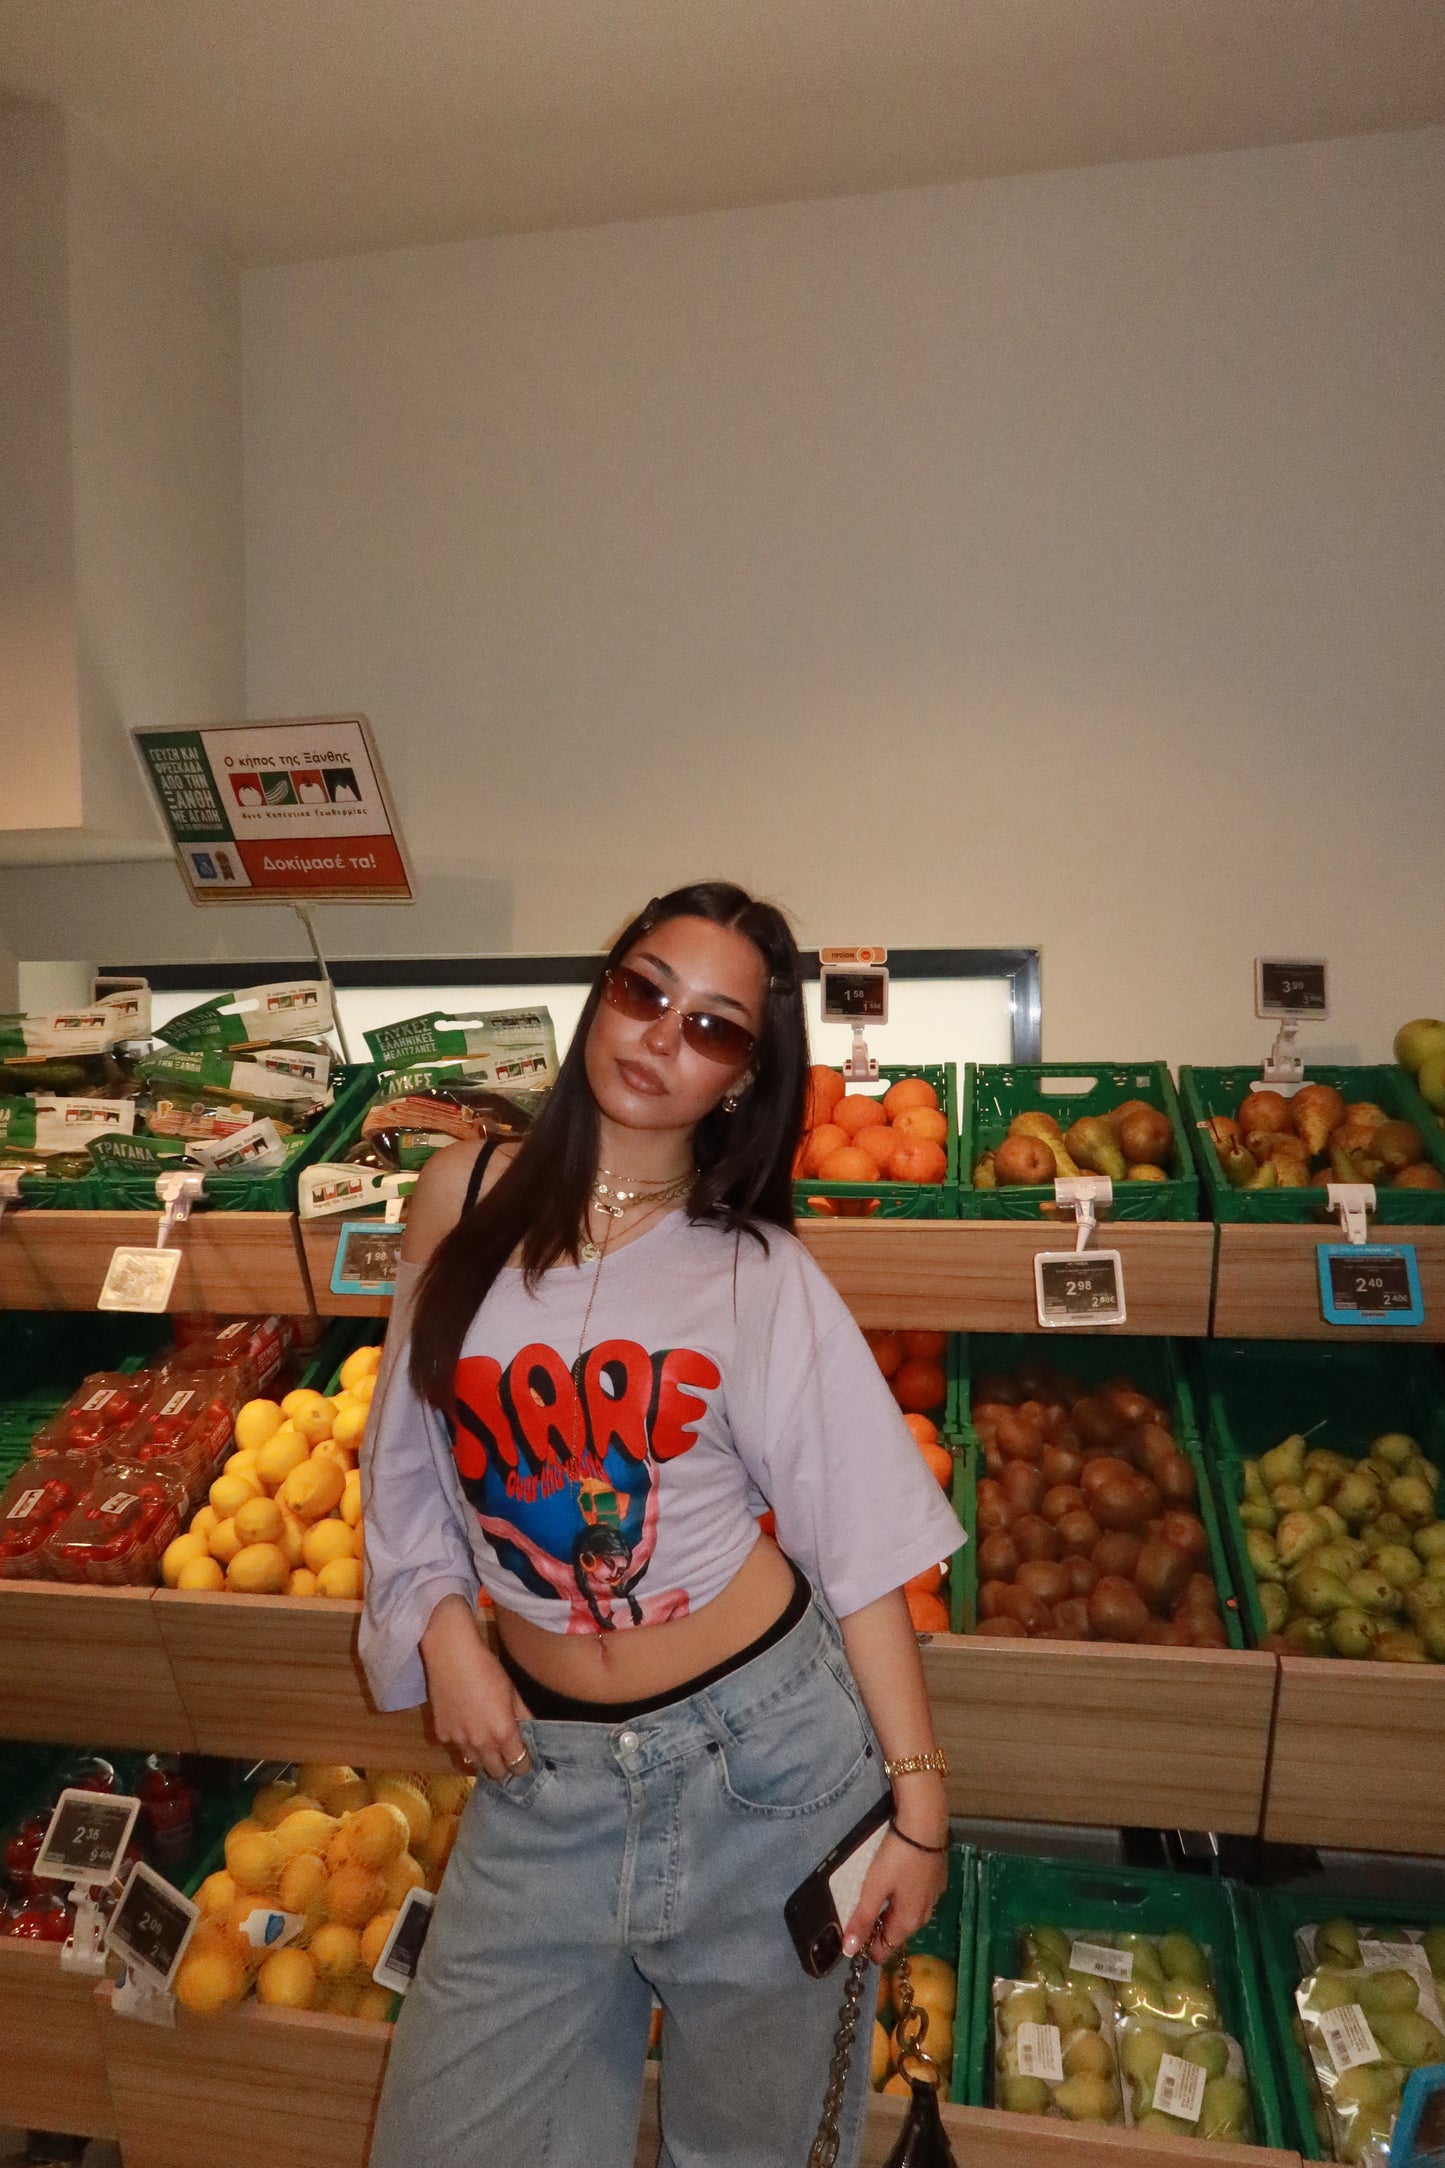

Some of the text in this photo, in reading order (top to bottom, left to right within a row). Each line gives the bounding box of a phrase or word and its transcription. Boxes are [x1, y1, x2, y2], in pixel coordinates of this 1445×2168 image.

[180, 746, 200, 760] ΚΑΙ
[238, 754, 276, 768] κήπος
[279, 755, 300, 767] της
[303, 750, 351, 764] Ξάνθης
[183, 773, 209, 789] ΤΗΝ
[164, 790, 216, 810] ΞΑΝΘΗ
[170, 810, 188, 823] ΜΕ
[263, 853, 377, 873] Δοκίμασέ τα!
